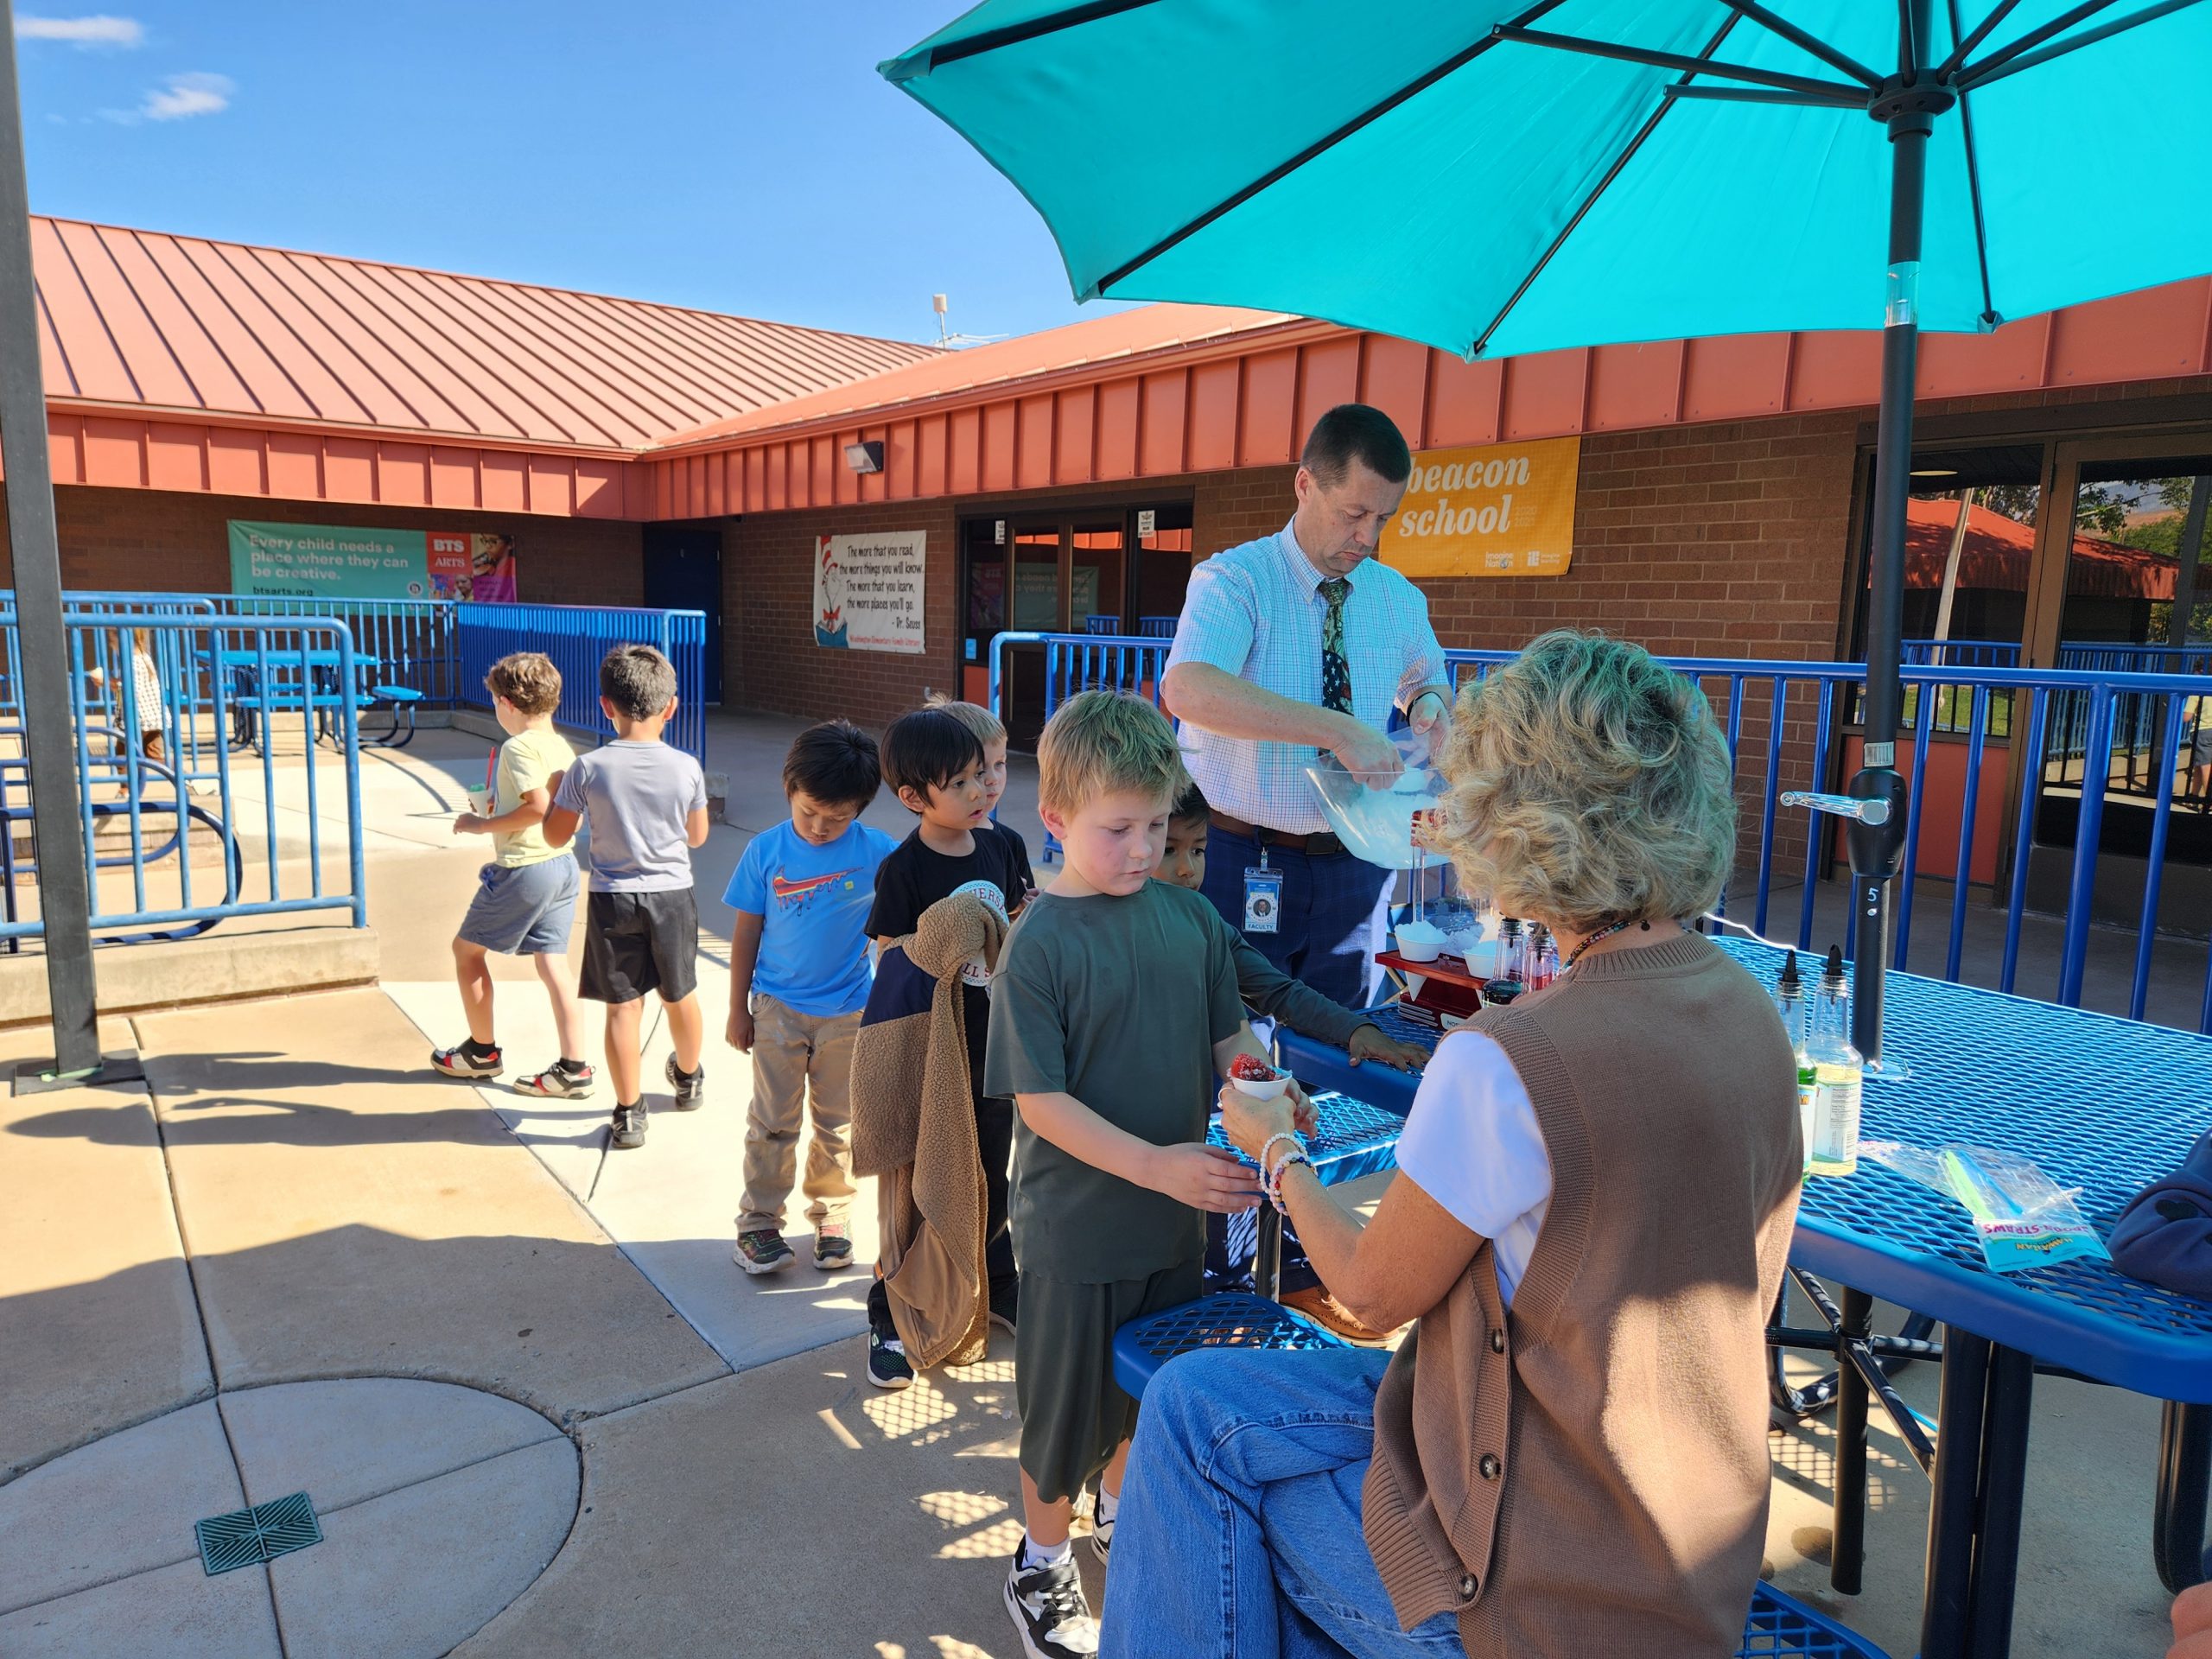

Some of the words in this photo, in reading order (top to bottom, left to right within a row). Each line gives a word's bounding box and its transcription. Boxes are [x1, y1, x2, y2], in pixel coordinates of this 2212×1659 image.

[1408, 455, 1530, 493] beacon
[1399, 493, 1512, 537] school
[250, 534, 293, 551] Every
[297, 537, 334, 550] child
[339, 541, 382, 553] needs
[386, 543, 394, 553] a
[434, 538, 465, 553] BTS
[848, 545, 857, 558] The
[859, 548, 872, 557] more
[874, 544, 886, 557] that
[887, 547, 898, 559] you
[251, 550, 293, 564] place
[296, 552, 343, 566] where
[347, 554, 378, 569] they
[383, 558, 409, 568] can
[435, 557, 465, 568] ARTS
[252, 564, 271, 577] be
[276, 567, 341, 580] creative.
[849, 565, 862, 575] more
[864, 562, 880, 576] things
[882, 565, 892, 576] you
[893, 562, 904, 575] will
[253, 585, 313, 596] btsarts.org
[847, 580, 856, 592] The
[858, 583, 870, 592] more
[872, 580, 884, 592] that
[886, 582, 896, 594] you
[847, 597, 855, 609] the
[857, 600, 869, 609] more
[871, 597, 888, 612] places
[906, 617, 920, 629] Seuss
[1867, 887, 1878, 901] 5
